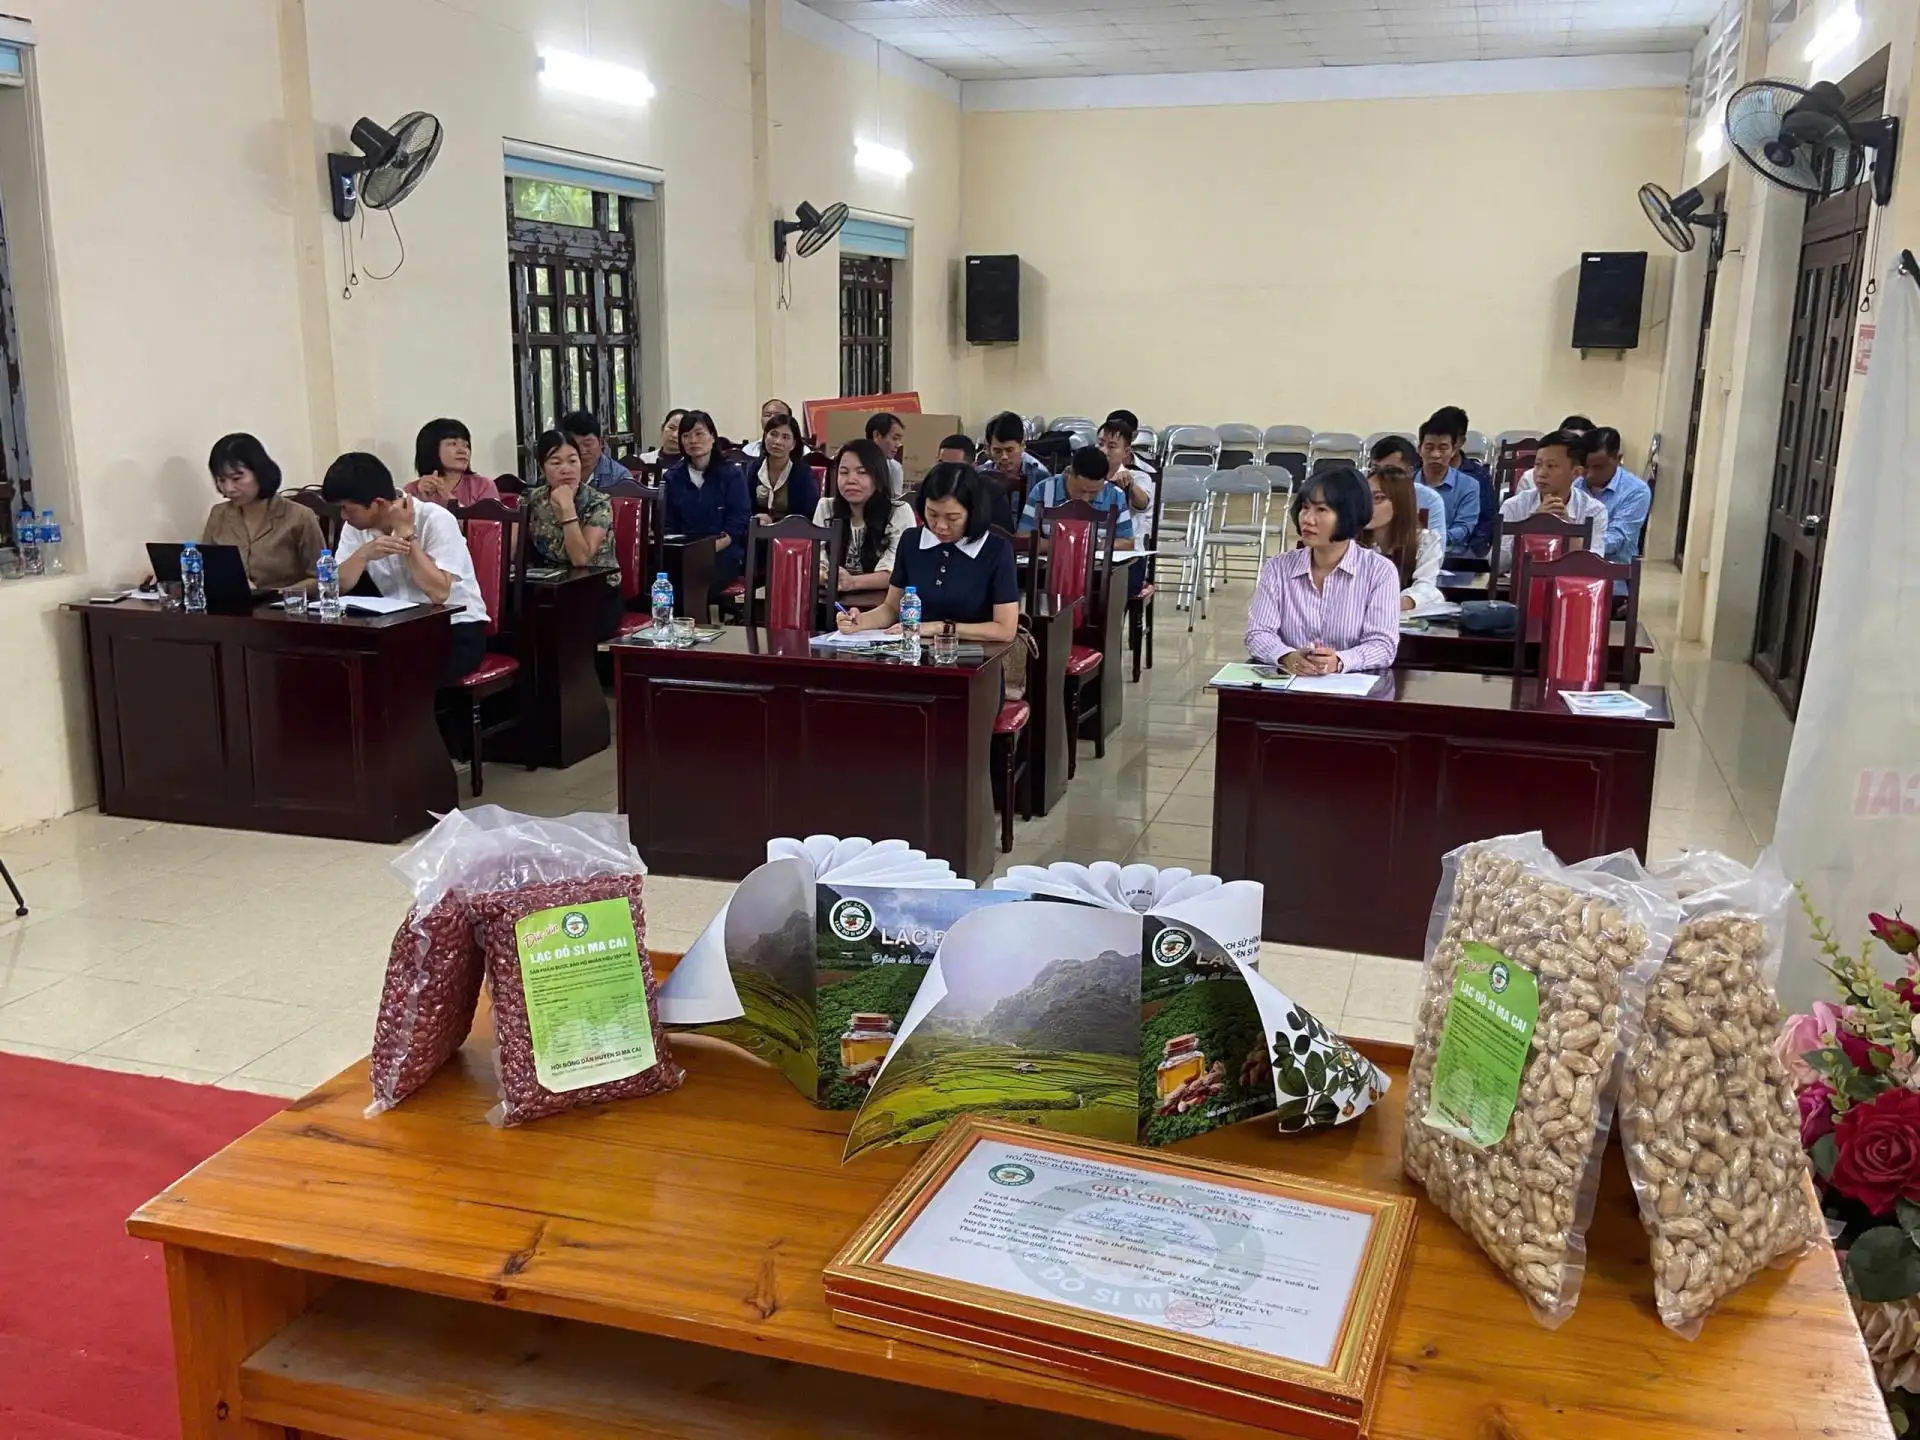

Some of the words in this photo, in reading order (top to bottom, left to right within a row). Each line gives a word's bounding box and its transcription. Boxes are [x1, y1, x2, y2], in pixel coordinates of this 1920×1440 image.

[530, 950, 552, 965] LẠC
[554, 944, 570, 960] ĐỎ
[572, 943, 585, 956] SI
[588, 940, 606, 953] MA
[608, 936, 628, 950] CAI
[881, 927, 927, 948] LẠC
[1460, 980, 1475, 998] LẠC
[1488, 999, 1496, 1012] SI
[1496, 1005, 1510, 1023] MA
[1511, 1015, 1527, 1033] CAI
